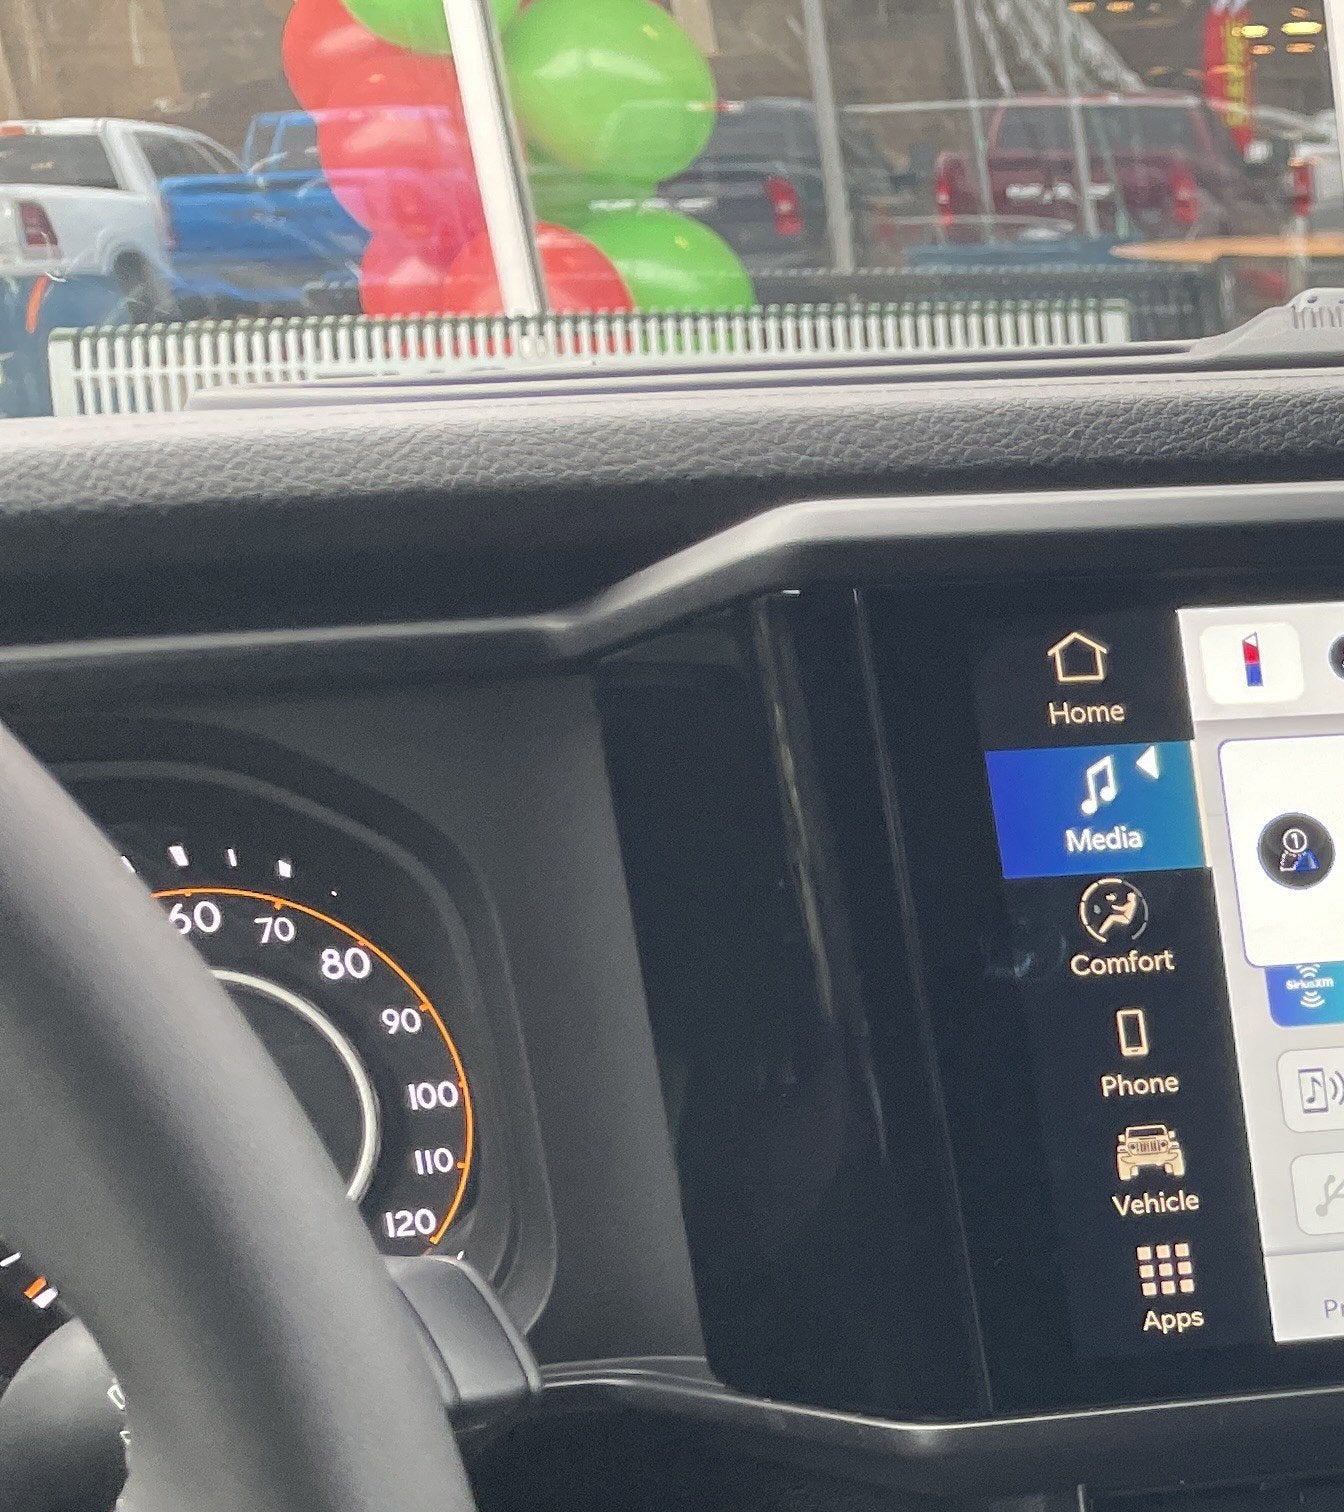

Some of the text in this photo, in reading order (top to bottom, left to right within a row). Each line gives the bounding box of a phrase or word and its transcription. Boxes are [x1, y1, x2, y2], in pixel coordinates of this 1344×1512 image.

[1049, 701, 1125, 725] Home
[1066, 828, 1144, 852] Media
[170, 901, 221, 935] 60
[255, 917, 295, 943] 70
[322, 947, 371, 981] 80
[1070, 950, 1175, 976] Comfort
[381, 1008, 422, 1035] 90
[408, 1082, 458, 1110] 100
[1101, 1073, 1180, 1097] Phone
[415, 1148, 454, 1175] 110
[1112, 1190, 1200, 1217] Vehicle
[385, 1209, 436, 1238] 120
[1143, 1309, 1204, 1334] Apps
